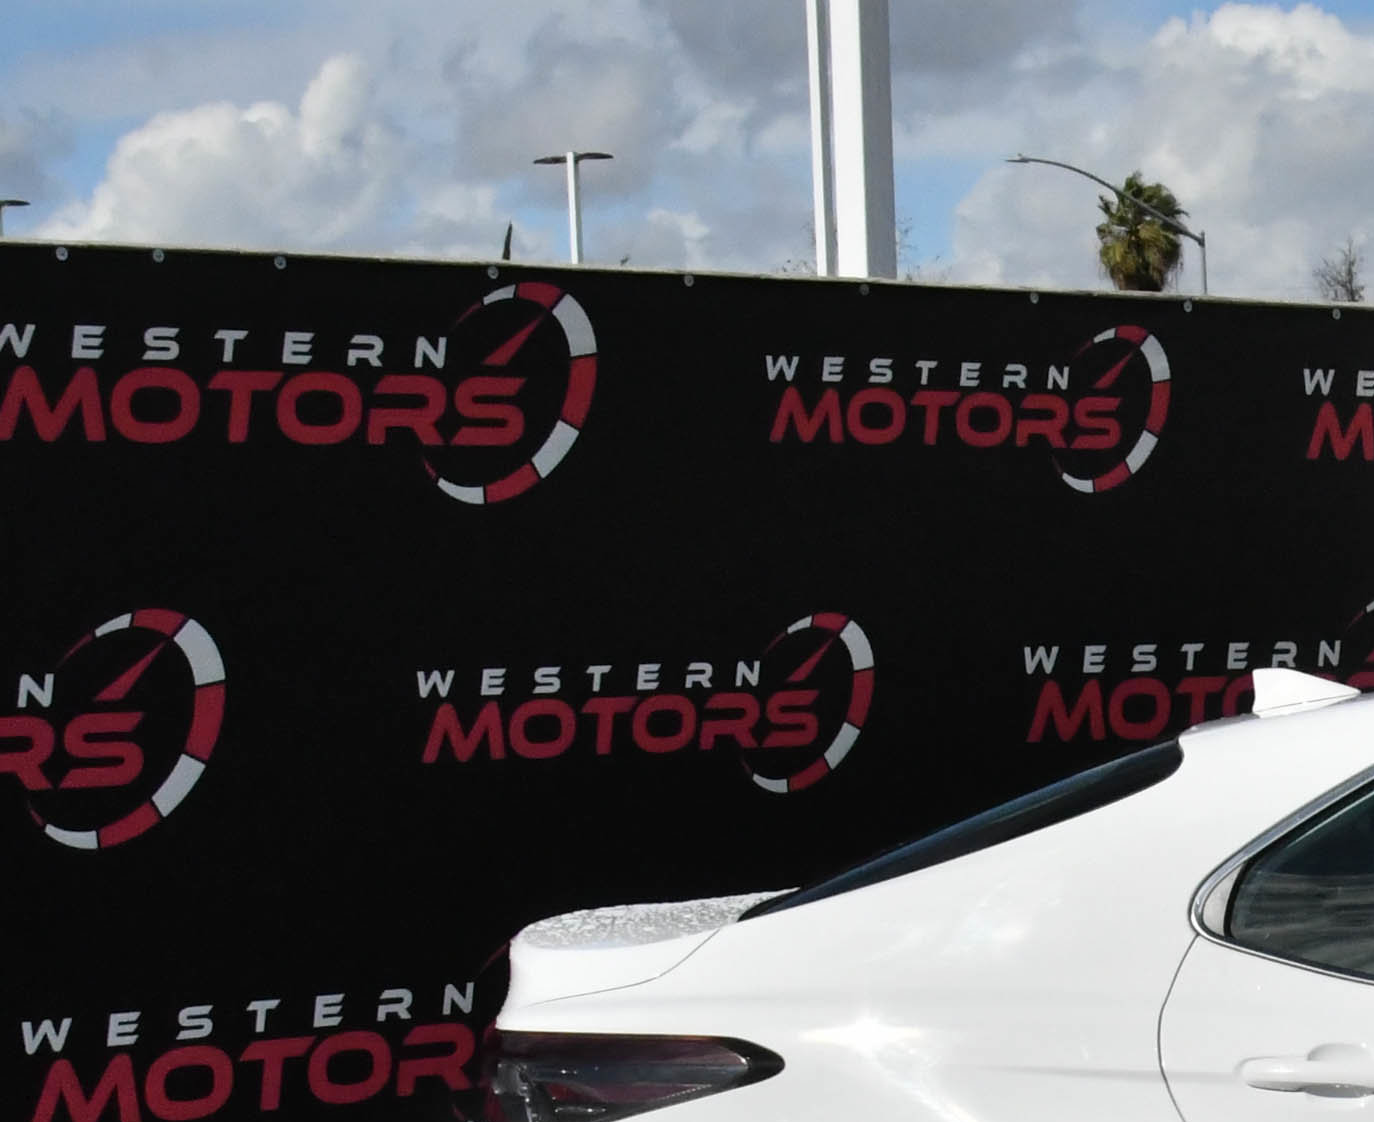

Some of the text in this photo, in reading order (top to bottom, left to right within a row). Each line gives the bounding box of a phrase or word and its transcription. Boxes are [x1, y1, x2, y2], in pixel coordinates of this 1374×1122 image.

[0, 322, 448, 370] WESTERN
[764, 354, 1071, 391] WESTERN
[0, 364, 527, 447] MOTORS
[769, 384, 1122, 451] MOTORS
[415, 659, 762, 700] WESTERN
[1022, 638, 1343, 675] WESTERN
[422, 688, 820, 764] MOTORS
[20, 981, 477, 1057] WESTERN
